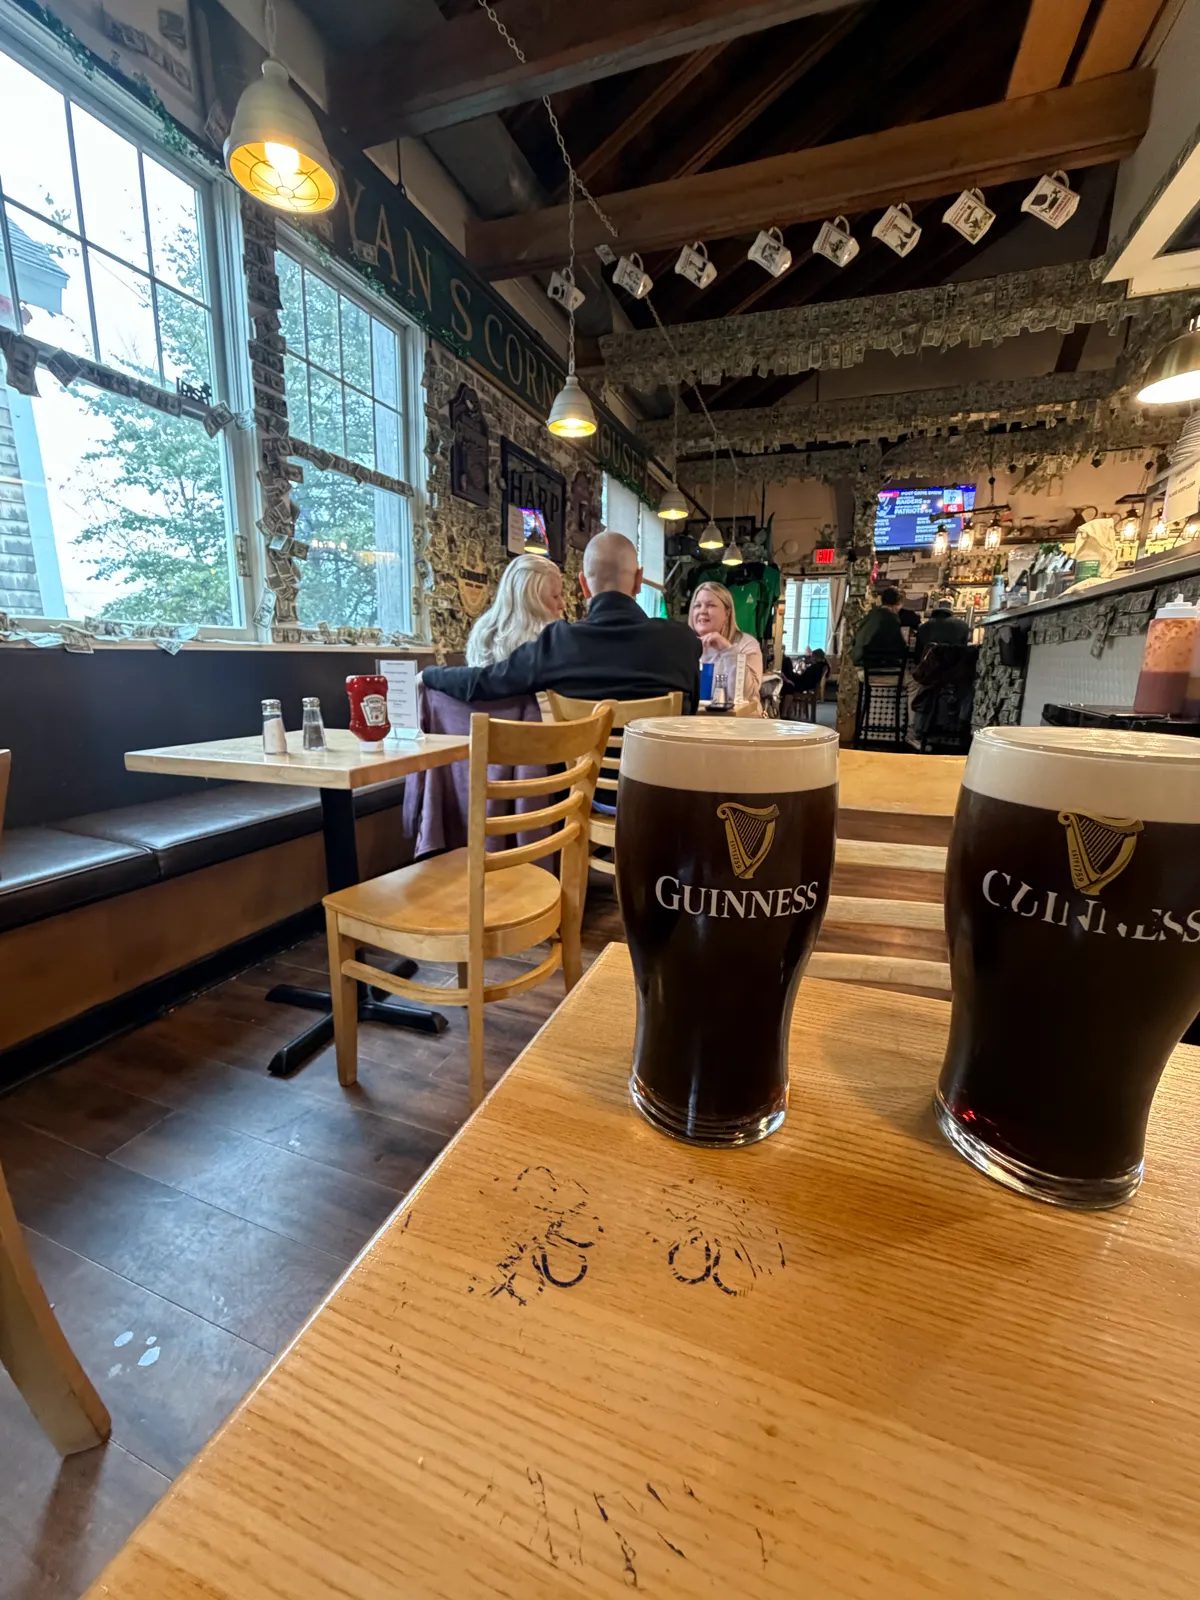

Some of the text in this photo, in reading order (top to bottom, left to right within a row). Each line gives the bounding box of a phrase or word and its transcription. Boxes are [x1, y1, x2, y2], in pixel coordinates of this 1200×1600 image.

[484, 313, 560, 410] CORN
[510, 469, 559, 527] HARP
[655, 875, 818, 919] GUINNESS
